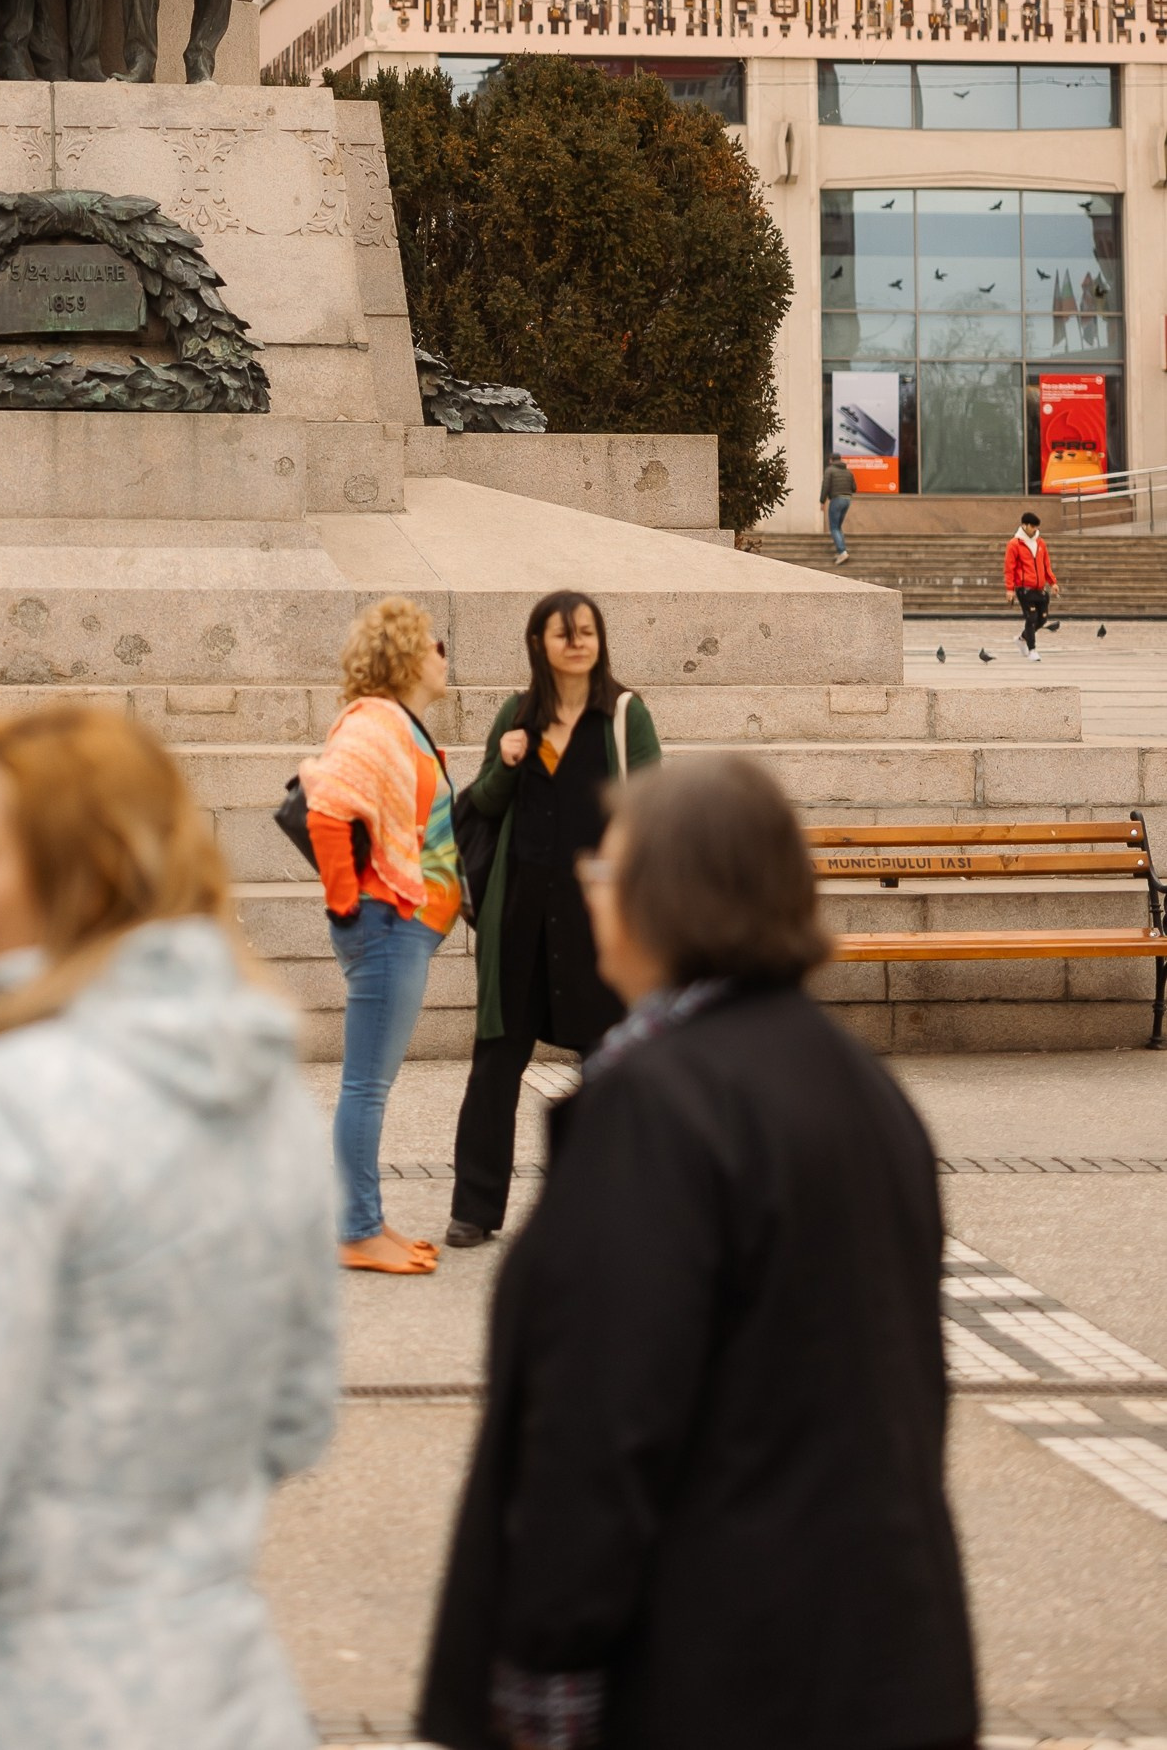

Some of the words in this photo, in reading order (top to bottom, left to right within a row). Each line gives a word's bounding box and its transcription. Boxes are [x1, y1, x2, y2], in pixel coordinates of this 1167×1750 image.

[47, 295, 86, 313] 1859
[1052, 441, 1096, 450] PRO
[828, 857, 931, 869] MUNICIPIULUI
